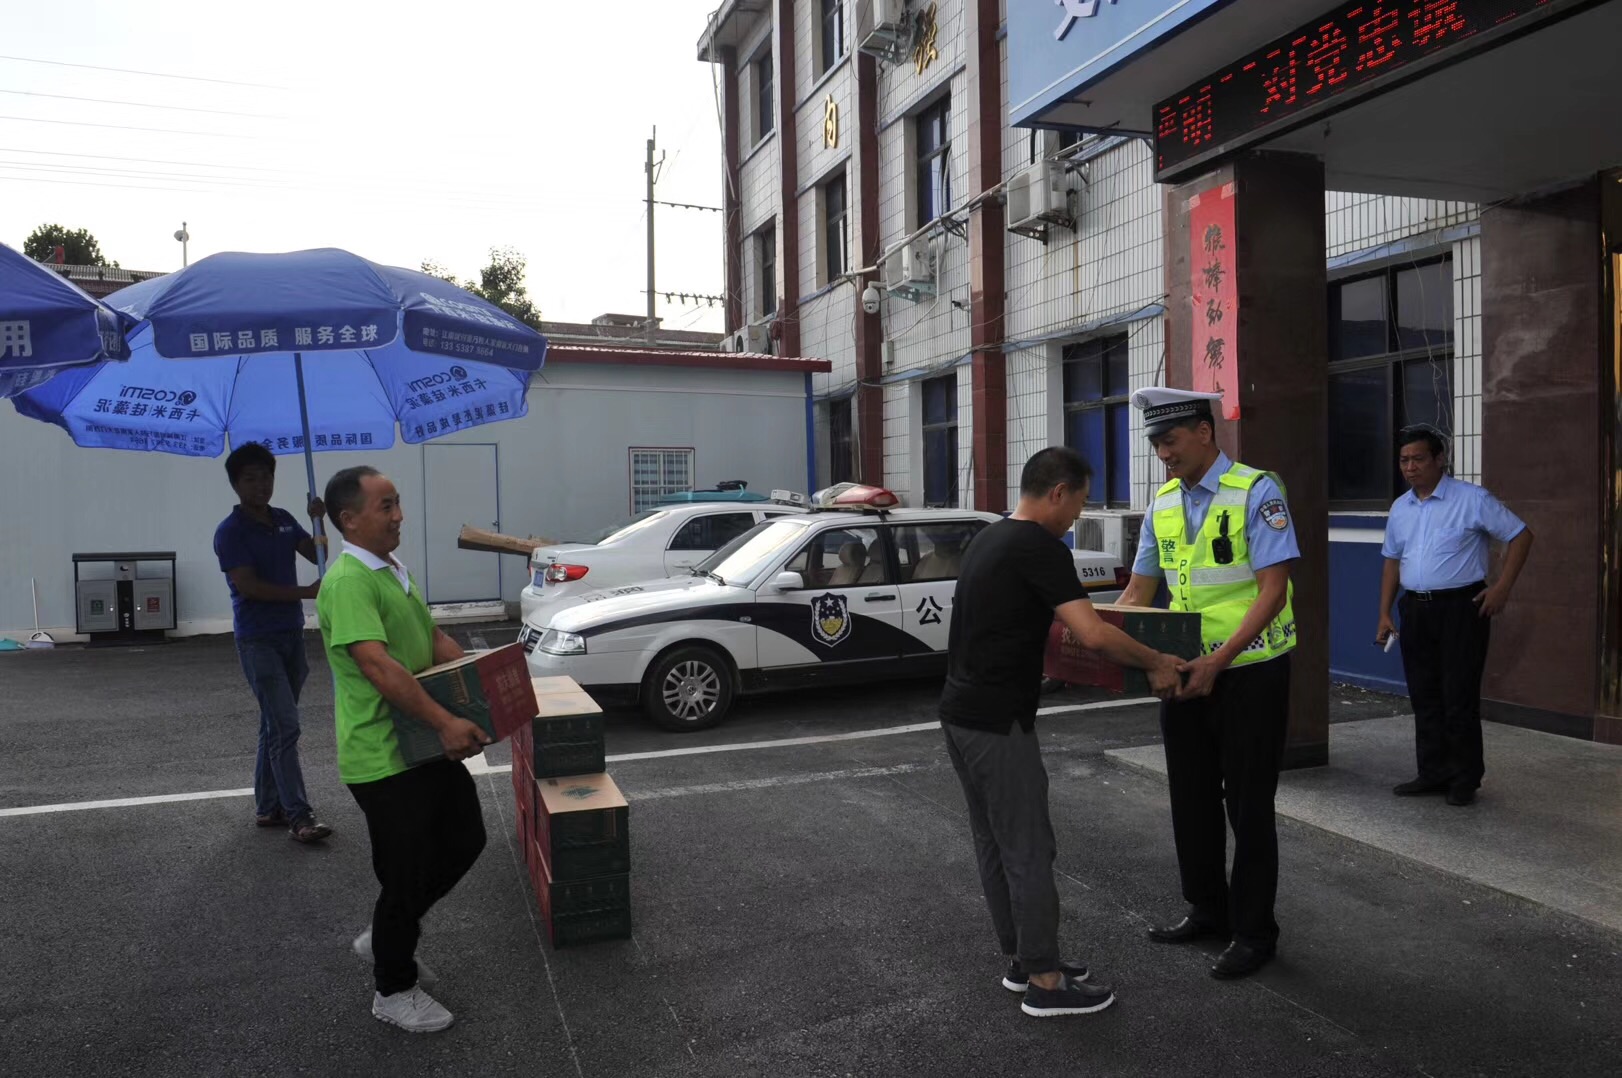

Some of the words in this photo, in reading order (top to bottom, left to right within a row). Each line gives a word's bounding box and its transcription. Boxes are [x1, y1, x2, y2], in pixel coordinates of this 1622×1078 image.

[0, 320, 32, 357] 用
[190, 329, 279, 353] 国际品质
[295, 324, 379, 346] 服务全球
[1161, 538, 1176, 563] 警
[1082, 566, 1106, 579] 5316
